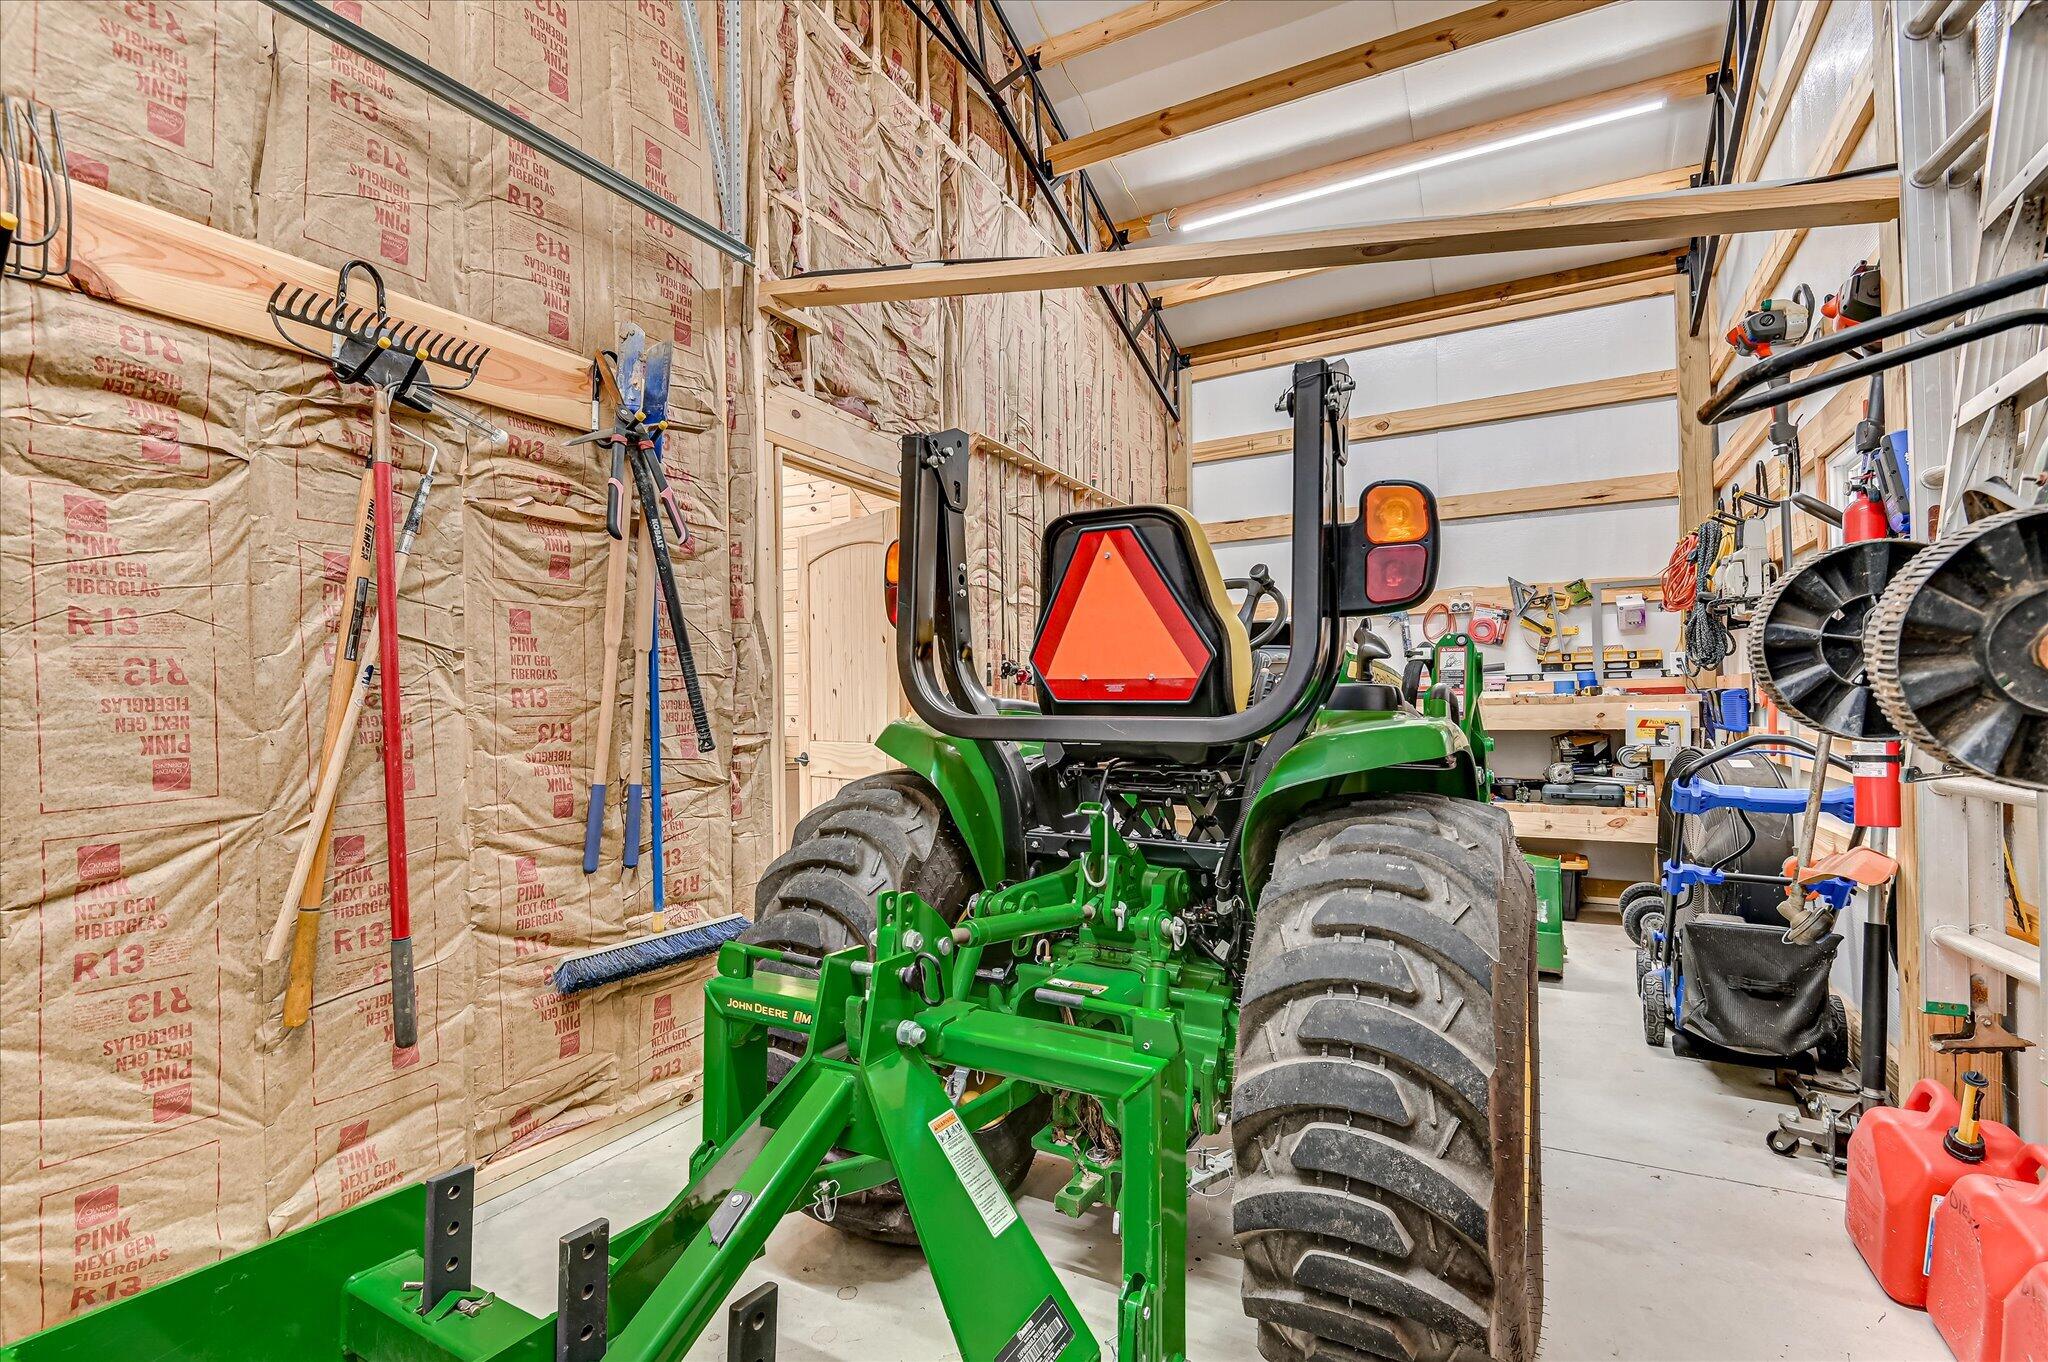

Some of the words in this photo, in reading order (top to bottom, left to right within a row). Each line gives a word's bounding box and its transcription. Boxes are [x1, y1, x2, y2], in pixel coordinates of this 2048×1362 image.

[638, 0, 666, 28] R13
[524, 8, 567, 46] FIBERGLAS
[530, 26, 547, 44] GEN
[100, 16, 187, 69] FIBERGLAS
[550, 39, 567, 60] NEXT
[112, 41, 144, 67] GEN
[331, 43, 361, 66] NEXT
[363, 61, 386, 81] GEN
[543, 47, 568, 76] PINK
[660, 39, 685, 73] R13
[151, 60, 187, 87] NEXT
[331, 57, 394, 100] FIBERGLAS
[652, 56, 686, 89] FIBERGLAS
[657, 71, 670, 89] GEN
[136, 70, 187, 112] PINK
[330, 78, 379, 122] R13
[672, 81, 688, 101] NEXT
[667, 90, 688, 115] PINK
[367, 139, 410, 180] R13
[509, 151, 529, 170] NEXT
[533, 162, 549, 180] GEN
[350, 162, 410, 200] FIBERGLAS
[508, 165, 555, 197] FIBERGLAS
[645, 163, 668, 188] PINK
[358, 182, 380, 199] GEN
[507, 183, 544, 219] R13
[664, 189, 678, 204] GEN
[374, 204, 410, 236] PINK
[535, 232, 570, 265] R13
[524, 254, 570, 284] FIBERGLAS
[666, 250, 693, 280] R13
[531, 271, 547, 288] GEN
[550, 280, 570, 298] NEXT
[656, 272, 692, 297] FIBERGLAS
[543, 290, 570, 315] PINK
[660, 287, 674, 300] GEN
[676, 293, 692, 308] NEXT
[670, 303, 692, 323] PINK
[119, 325, 184, 365] R13
[94, 355, 183, 391] FIBERGLAS
[101, 378, 135, 396] GEN
[140, 386, 181, 408] NEXT
[508, 415, 556, 437] FIBERGLAS
[508, 435, 545, 462] R13
[527, 523, 545, 535] GEN
[547, 526, 568, 537] NEXT
[651, 518, 664, 550] KOBALT
[66, 533, 121, 554] PINK
[542, 537, 571, 553] PINK
[67, 562, 108, 576] NEXT
[115, 561, 148, 578] GEN
[67, 578, 161, 598] FIBERGLAS
[323, 584, 346, 600] PIN
[68, 605, 139, 636] R13
[510, 637, 538, 652] PINK
[123, 657, 189, 686] R13
[511, 655, 531, 666] NEXT
[534, 656, 550, 667] GEN
[511, 668, 557, 680] FIBERGLAS
[100, 697, 189, 713] FIBERGLAS
[511, 687, 548, 708] R13
[115, 716, 147, 733] GEN
[152, 715, 190, 731] NEXT
[665, 713, 679, 722] GEN
[359, 731, 382, 745] GEN
[538, 723, 572, 743] R13
[140, 734, 191, 757] PINK
[525, 751, 571, 764] FIBERGLAS
[534, 766, 549, 777] GEN
[547, 778, 573, 793] PINK
[670, 819, 685, 831] GEN
[663, 848, 681, 867] 13
[81, 866, 119, 878] CORNING
[334, 865, 373, 887] PINK
[334, 888, 363, 904] NEXT
[368, 882, 390, 896] GEN
[517, 883, 545, 902] PINK
[672, 875, 700, 897] R13
[75, 901, 118, 922] NEXT
[123, 896, 157, 915] GEN
[334, 899, 391, 920] FIBERGLA
[516, 901, 538, 917] NEXT
[540, 898, 557, 912] GEN
[75, 913, 168, 941] FIBERGLAS
[516, 910, 564, 930] FIBERGLAS
[334, 922, 385, 954] R13
[514, 932, 552, 957] R13
[73, 944, 145, 983] R13
[128, 986, 192, 1023] R13
[541, 1005, 558, 1022] GEN
[561, 1000, 580, 1016] NEXT
[726, 998, 753, 1012] JOHN
[755, 1003, 788, 1019] DEERE
[366, 1010, 390, 1027] GEN
[555, 1013, 581, 1036] PINK
[652, 1017, 676, 1036] PINK
[103, 1022, 192, 1056] FIBERGLAS
[651, 1032, 669, 1047] NEXT
[673, 1027, 687, 1040] GEN
[155, 1041, 192, 1063] NEXT
[116, 1055, 149, 1072] GEN
[651, 1058, 682, 1081] R13
[141, 1059, 192, 1091] PINK
[336, 1143, 379, 1174] PINK
[340, 1169, 369, 1192] NEXT
[374, 1159, 396, 1178] GEN
[75, 1217, 130, 1256] PINK
[74, 1248, 169, 1281] FIBERGLAS
[75, 1250, 117, 1273] NEXT
[124, 1234, 156, 1259] GEN
[70, 1276, 141, 1311] R13
